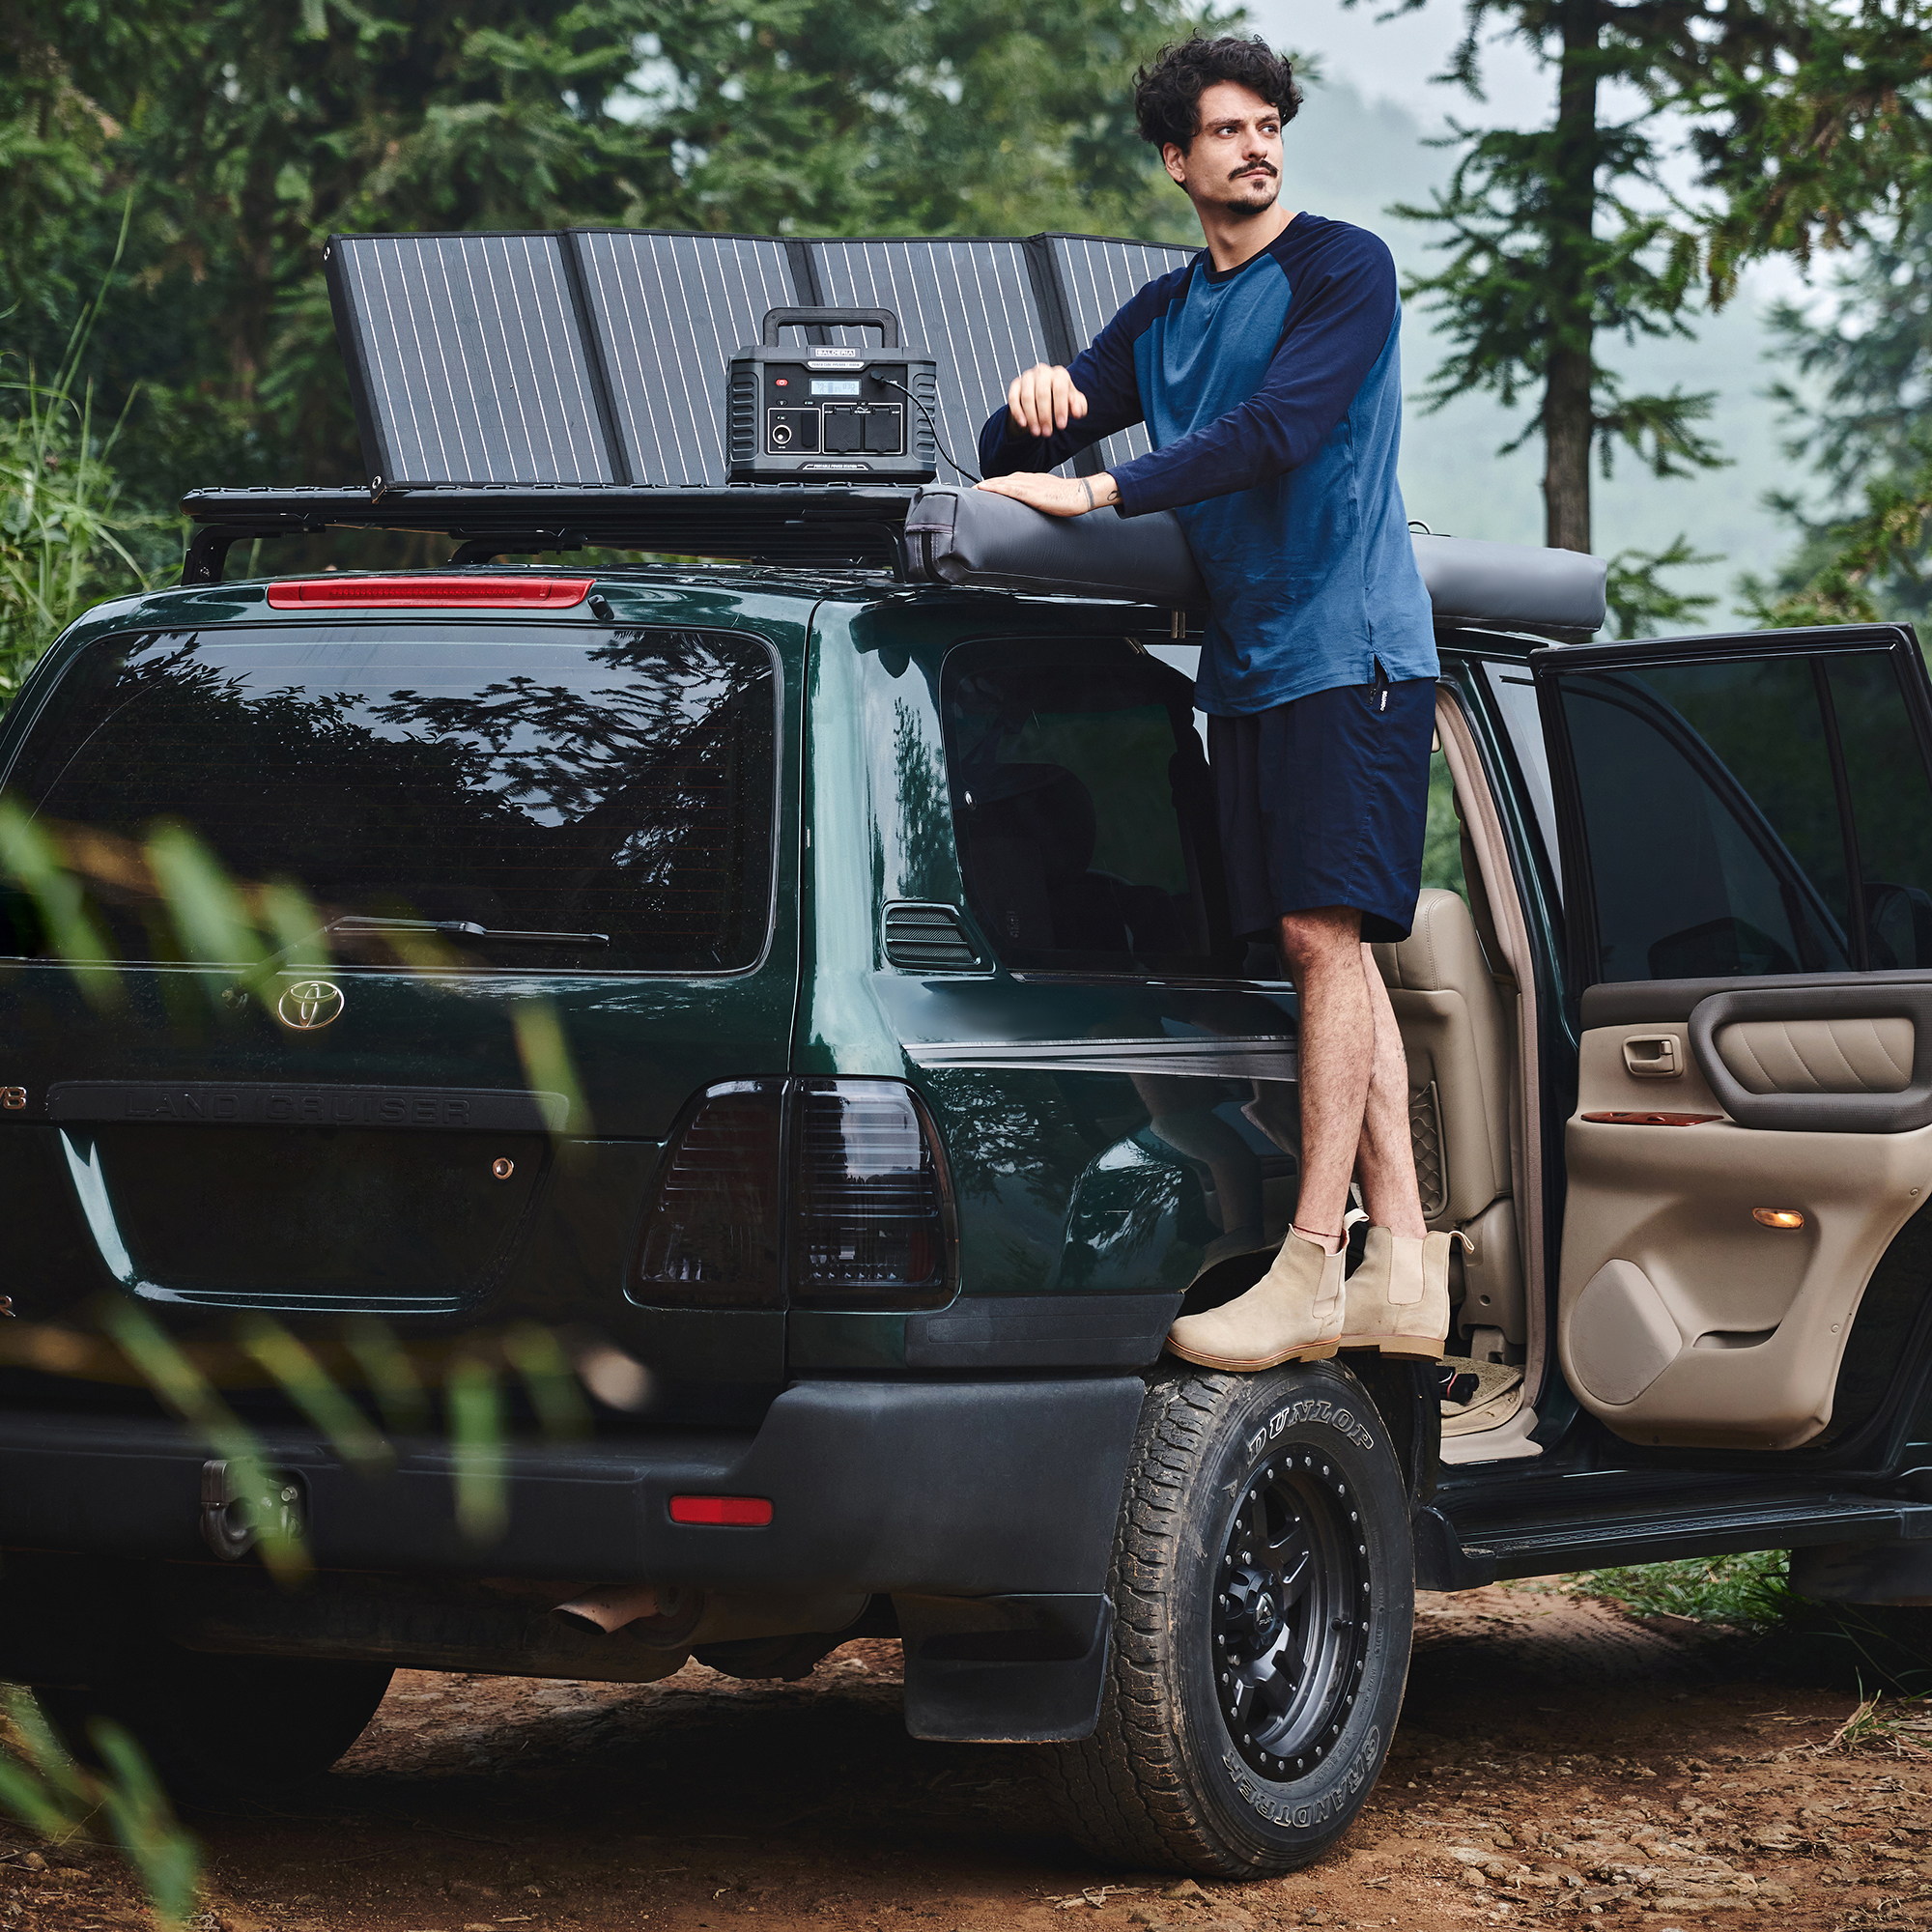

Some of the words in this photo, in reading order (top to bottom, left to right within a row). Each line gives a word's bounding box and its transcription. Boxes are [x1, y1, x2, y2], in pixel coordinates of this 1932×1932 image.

[125, 1092, 240, 1119] LAND
[265, 1094, 471, 1125] CRUISER
[1247, 1399, 1375, 1469] DUNLOP
[1221, 1724, 1380, 1829] GRANDTREK
